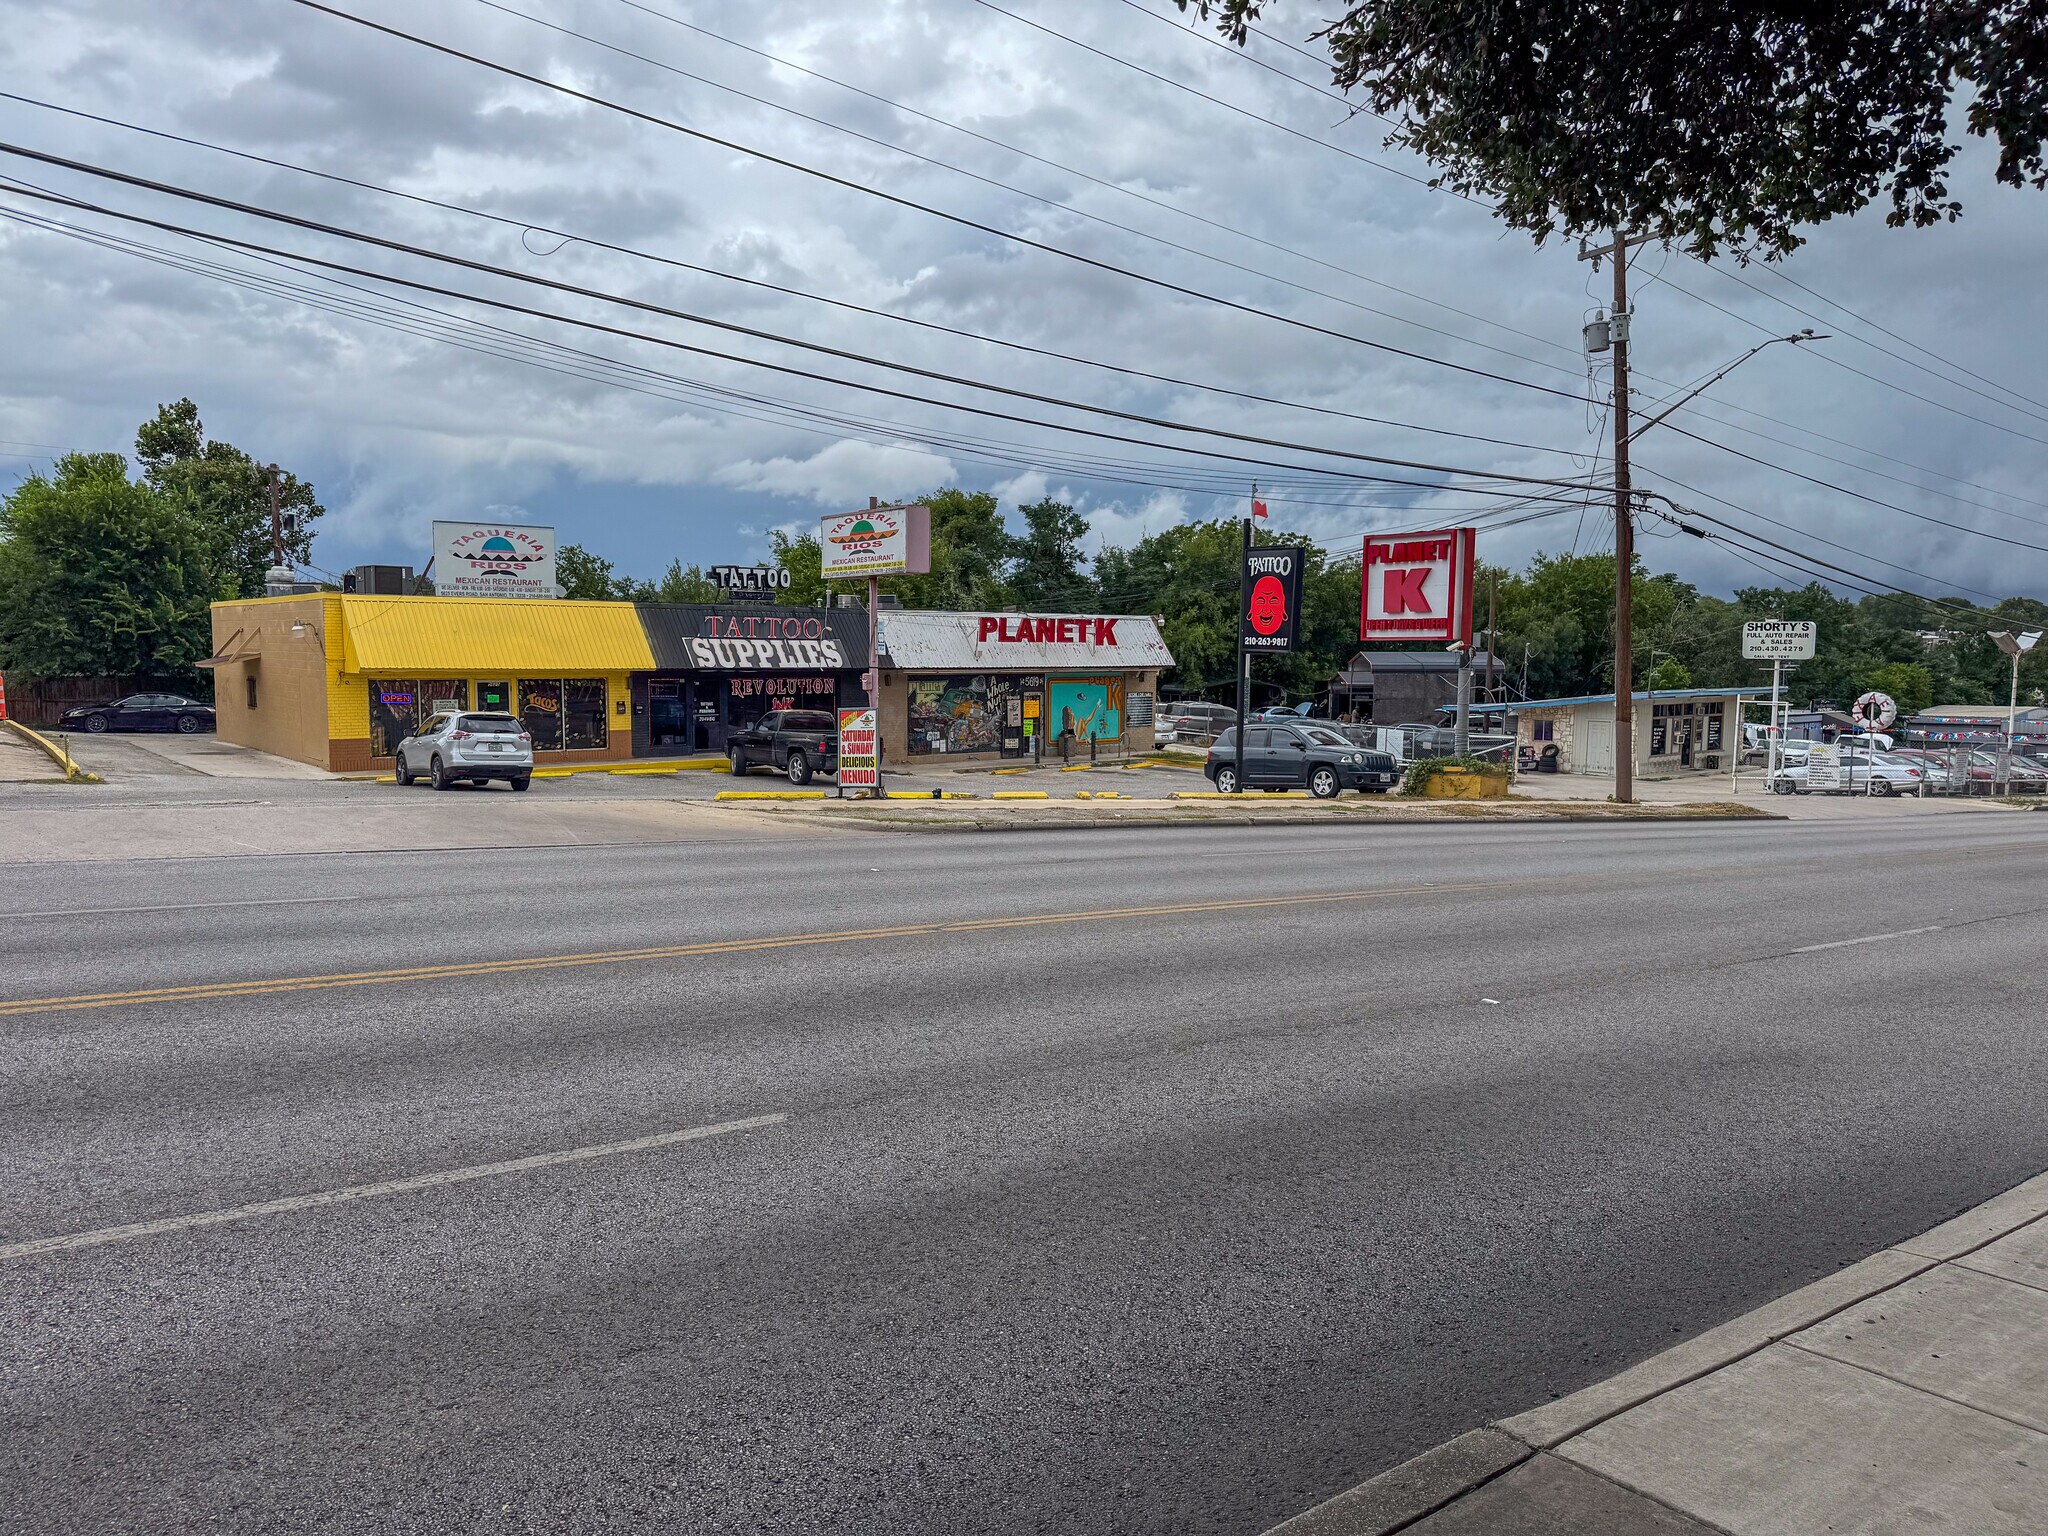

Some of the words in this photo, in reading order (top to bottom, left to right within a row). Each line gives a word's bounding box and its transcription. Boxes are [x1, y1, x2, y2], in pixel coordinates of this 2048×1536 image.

[831, 513, 897, 534] TAQUERIA
[451, 529, 544, 552] TAQUERIA
[842, 541, 883, 551] RIOS
[1368, 540, 1451, 564] PLANET
[470, 561, 528, 570] RIOS
[832, 557, 856, 566] MEXICAN
[856, 554, 895, 563] RESTAURANT
[1248, 556, 1292, 576] TATTOO
[492, 578, 543, 587] RESTAURANT
[716, 568, 790, 589] TATTOO
[1383, 568, 1432, 614] K
[704, 616, 822, 639] TATTOO
[978, 616, 1092, 642] PLANET
[1095, 618, 1119, 646] K
[1366, 619, 1385, 630] OPEN
[1393, 619, 1414, 630] DAYS
[1422, 618, 1447, 630] WEEK
[1747, 622, 1810, 631] SHORTY'S
[1244, 637, 1288, 646] 210-263-9817
[692, 638, 843, 668] SUPPLIES
[731, 678, 834, 698] REVOLUTION
[1025, 676, 1039, 686] 5619
[527, 692, 558, 709] Tacos
[842, 730, 875, 742] SATURDAY
[842, 745, 846, 755] &
[848, 743, 874, 754] SUNDAY
[842, 757, 875, 768] DELICIOUS
[841, 770, 875, 784] MENUDO
